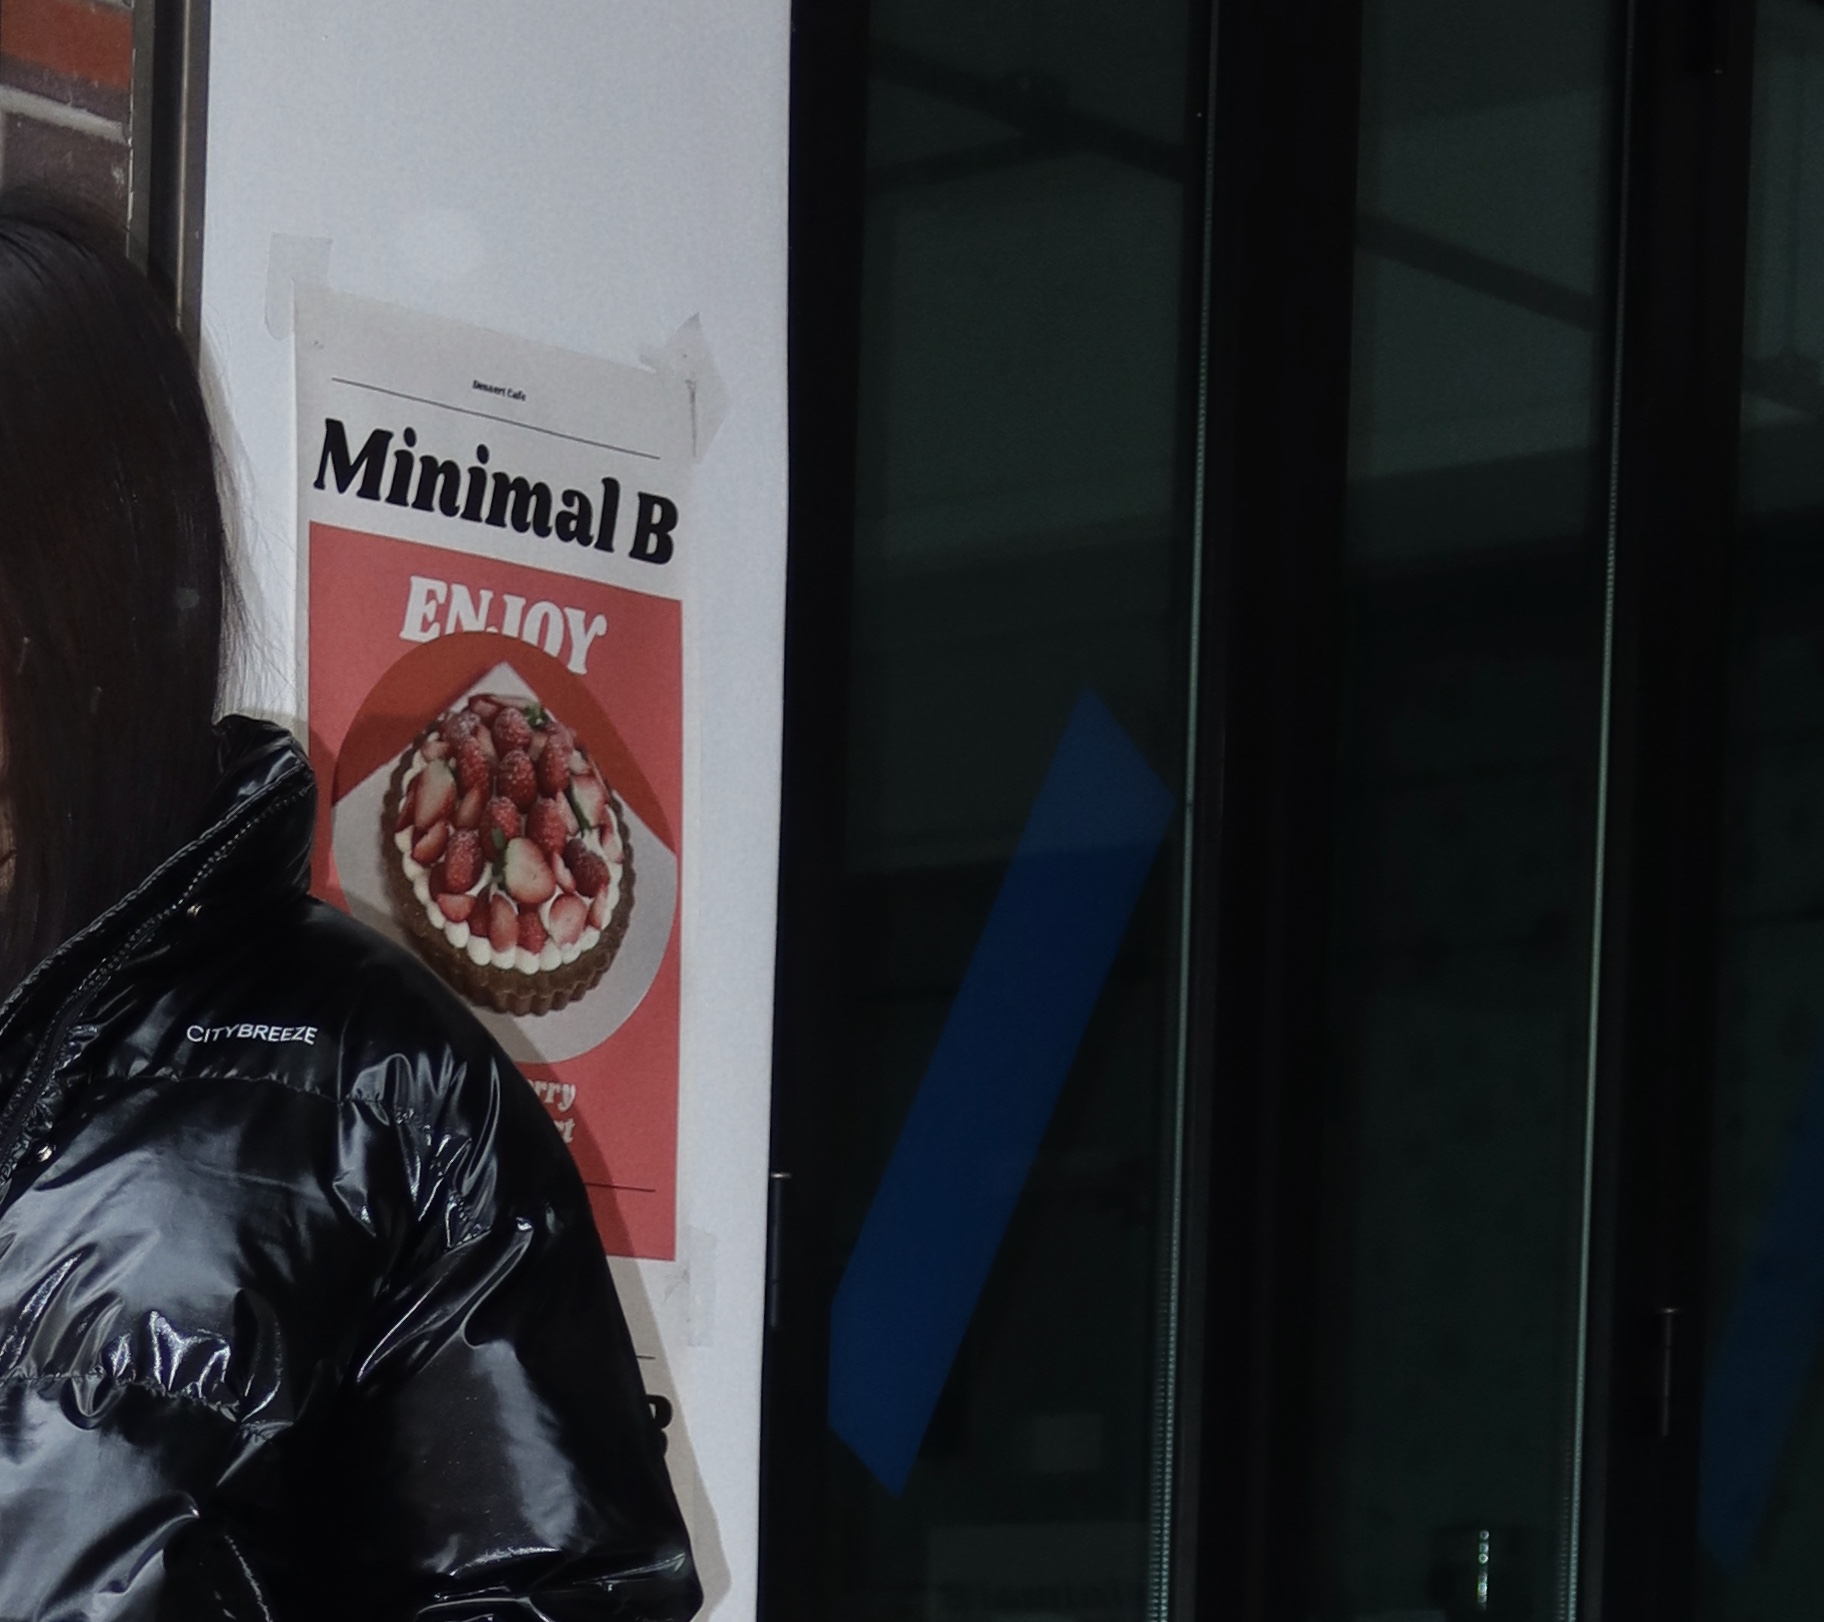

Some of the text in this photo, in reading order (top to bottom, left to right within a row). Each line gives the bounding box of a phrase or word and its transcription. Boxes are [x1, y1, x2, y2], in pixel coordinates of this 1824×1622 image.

[314, 417, 679, 566] Minimal B
[399, 574, 607, 676] ENJOY
[186, 1023, 319, 1046] CITYBREEZE
